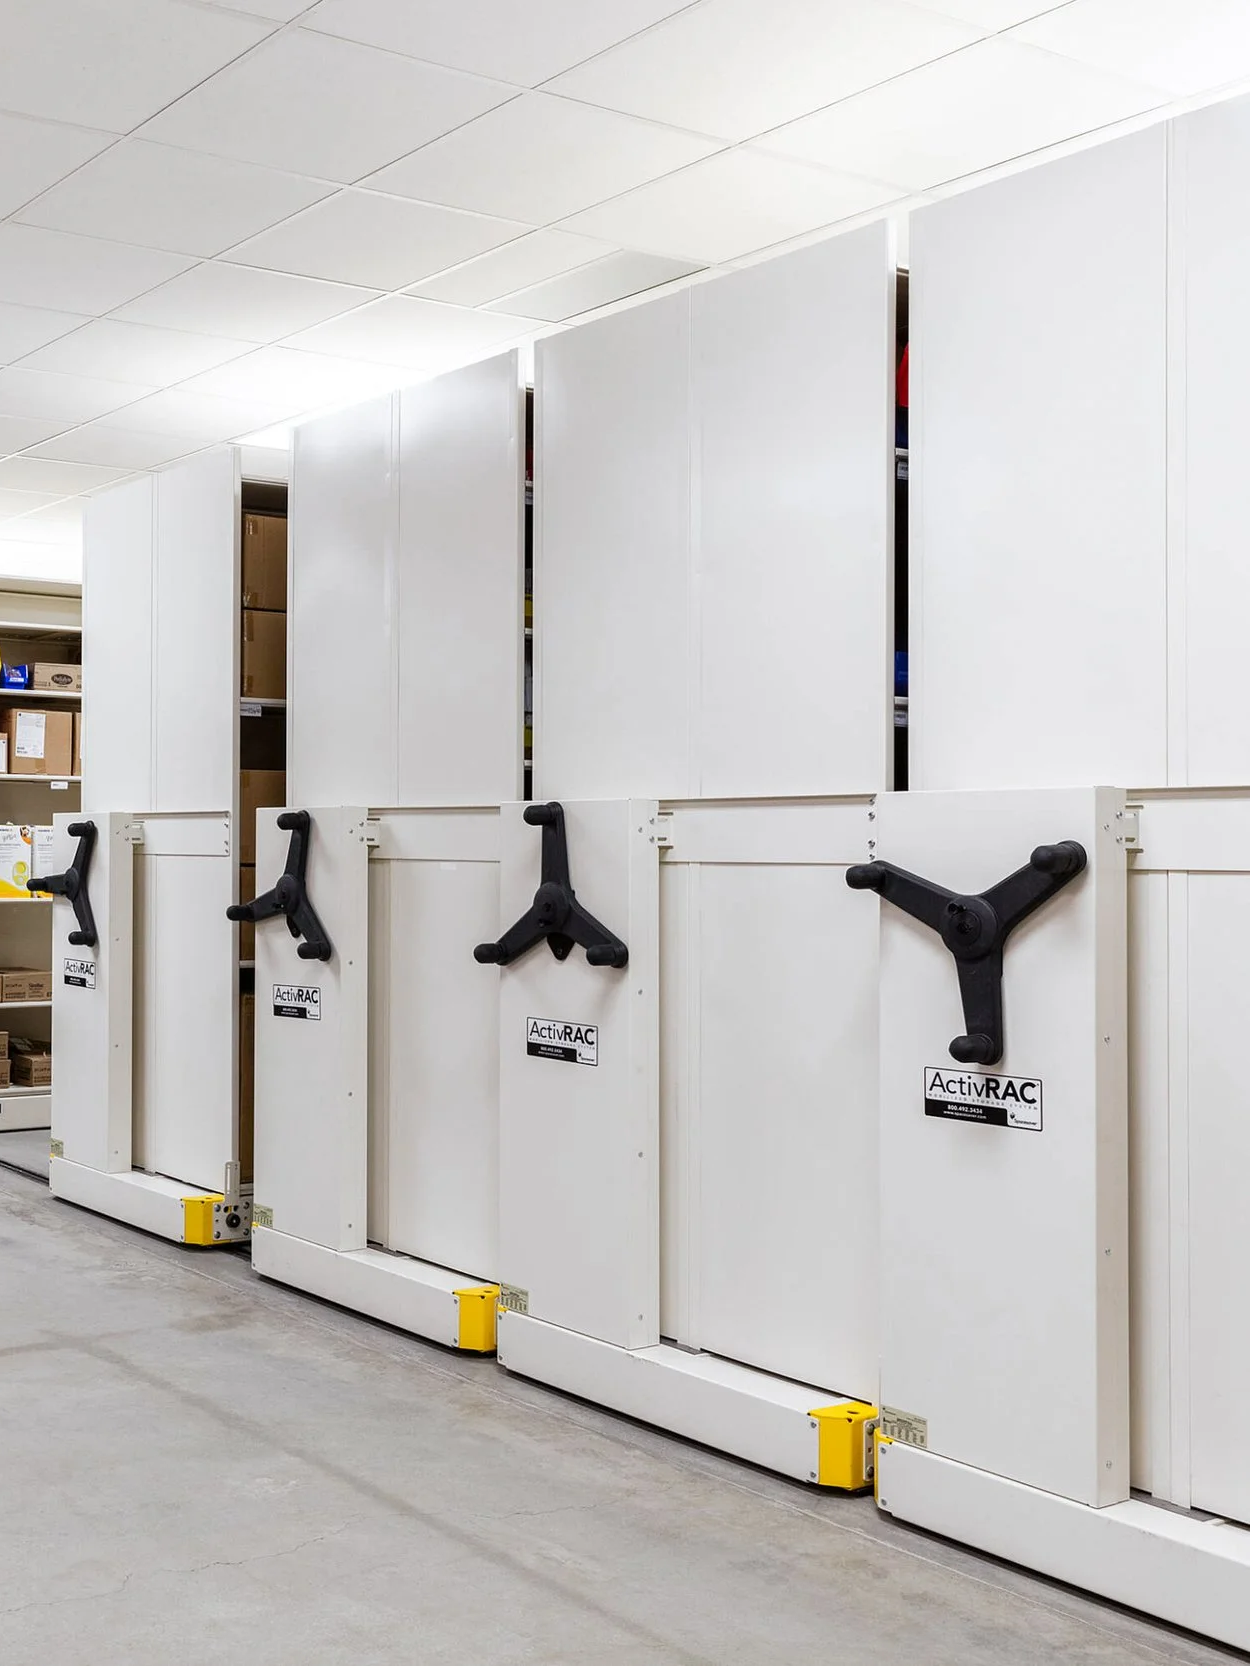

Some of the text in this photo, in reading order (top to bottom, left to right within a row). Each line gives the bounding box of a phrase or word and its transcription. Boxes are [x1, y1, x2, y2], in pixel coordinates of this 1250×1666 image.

[275, 987, 319, 1004] ActivRAC
[529, 1020, 595, 1046] ActivRAC
[928, 1071, 1038, 1105] ActivRAC
[947, 1103, 983, 1115] 800.492.3434
